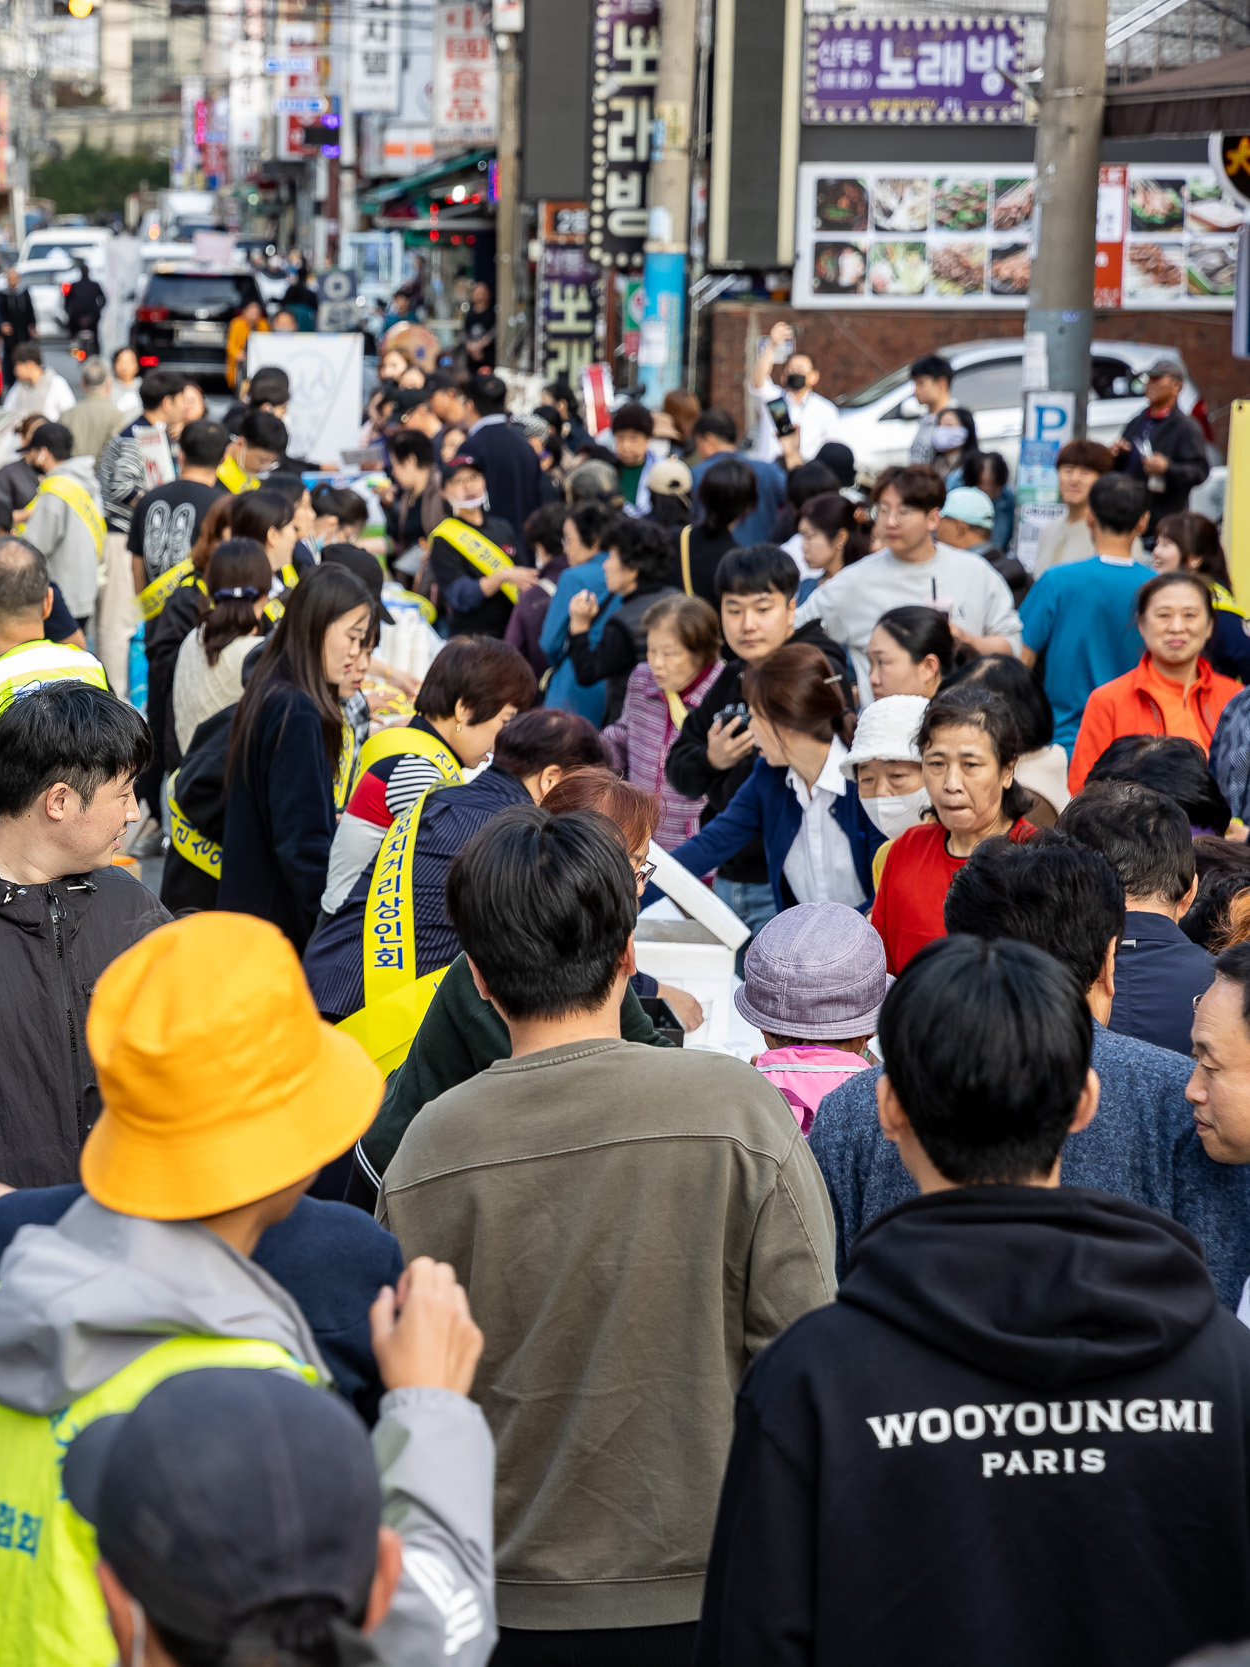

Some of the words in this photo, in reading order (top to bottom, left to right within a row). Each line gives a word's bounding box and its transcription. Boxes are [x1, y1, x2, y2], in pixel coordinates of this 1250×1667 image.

[875, 33, 1017, 97] 노래방
[1034, 406, 1068, 443] P
[65, 1007, 78, 1053] LIFEWORK
[865, 1399, 1214, 1449] WOOYOUNGMI
[981, 1448, 1107, 1478] PARIS
